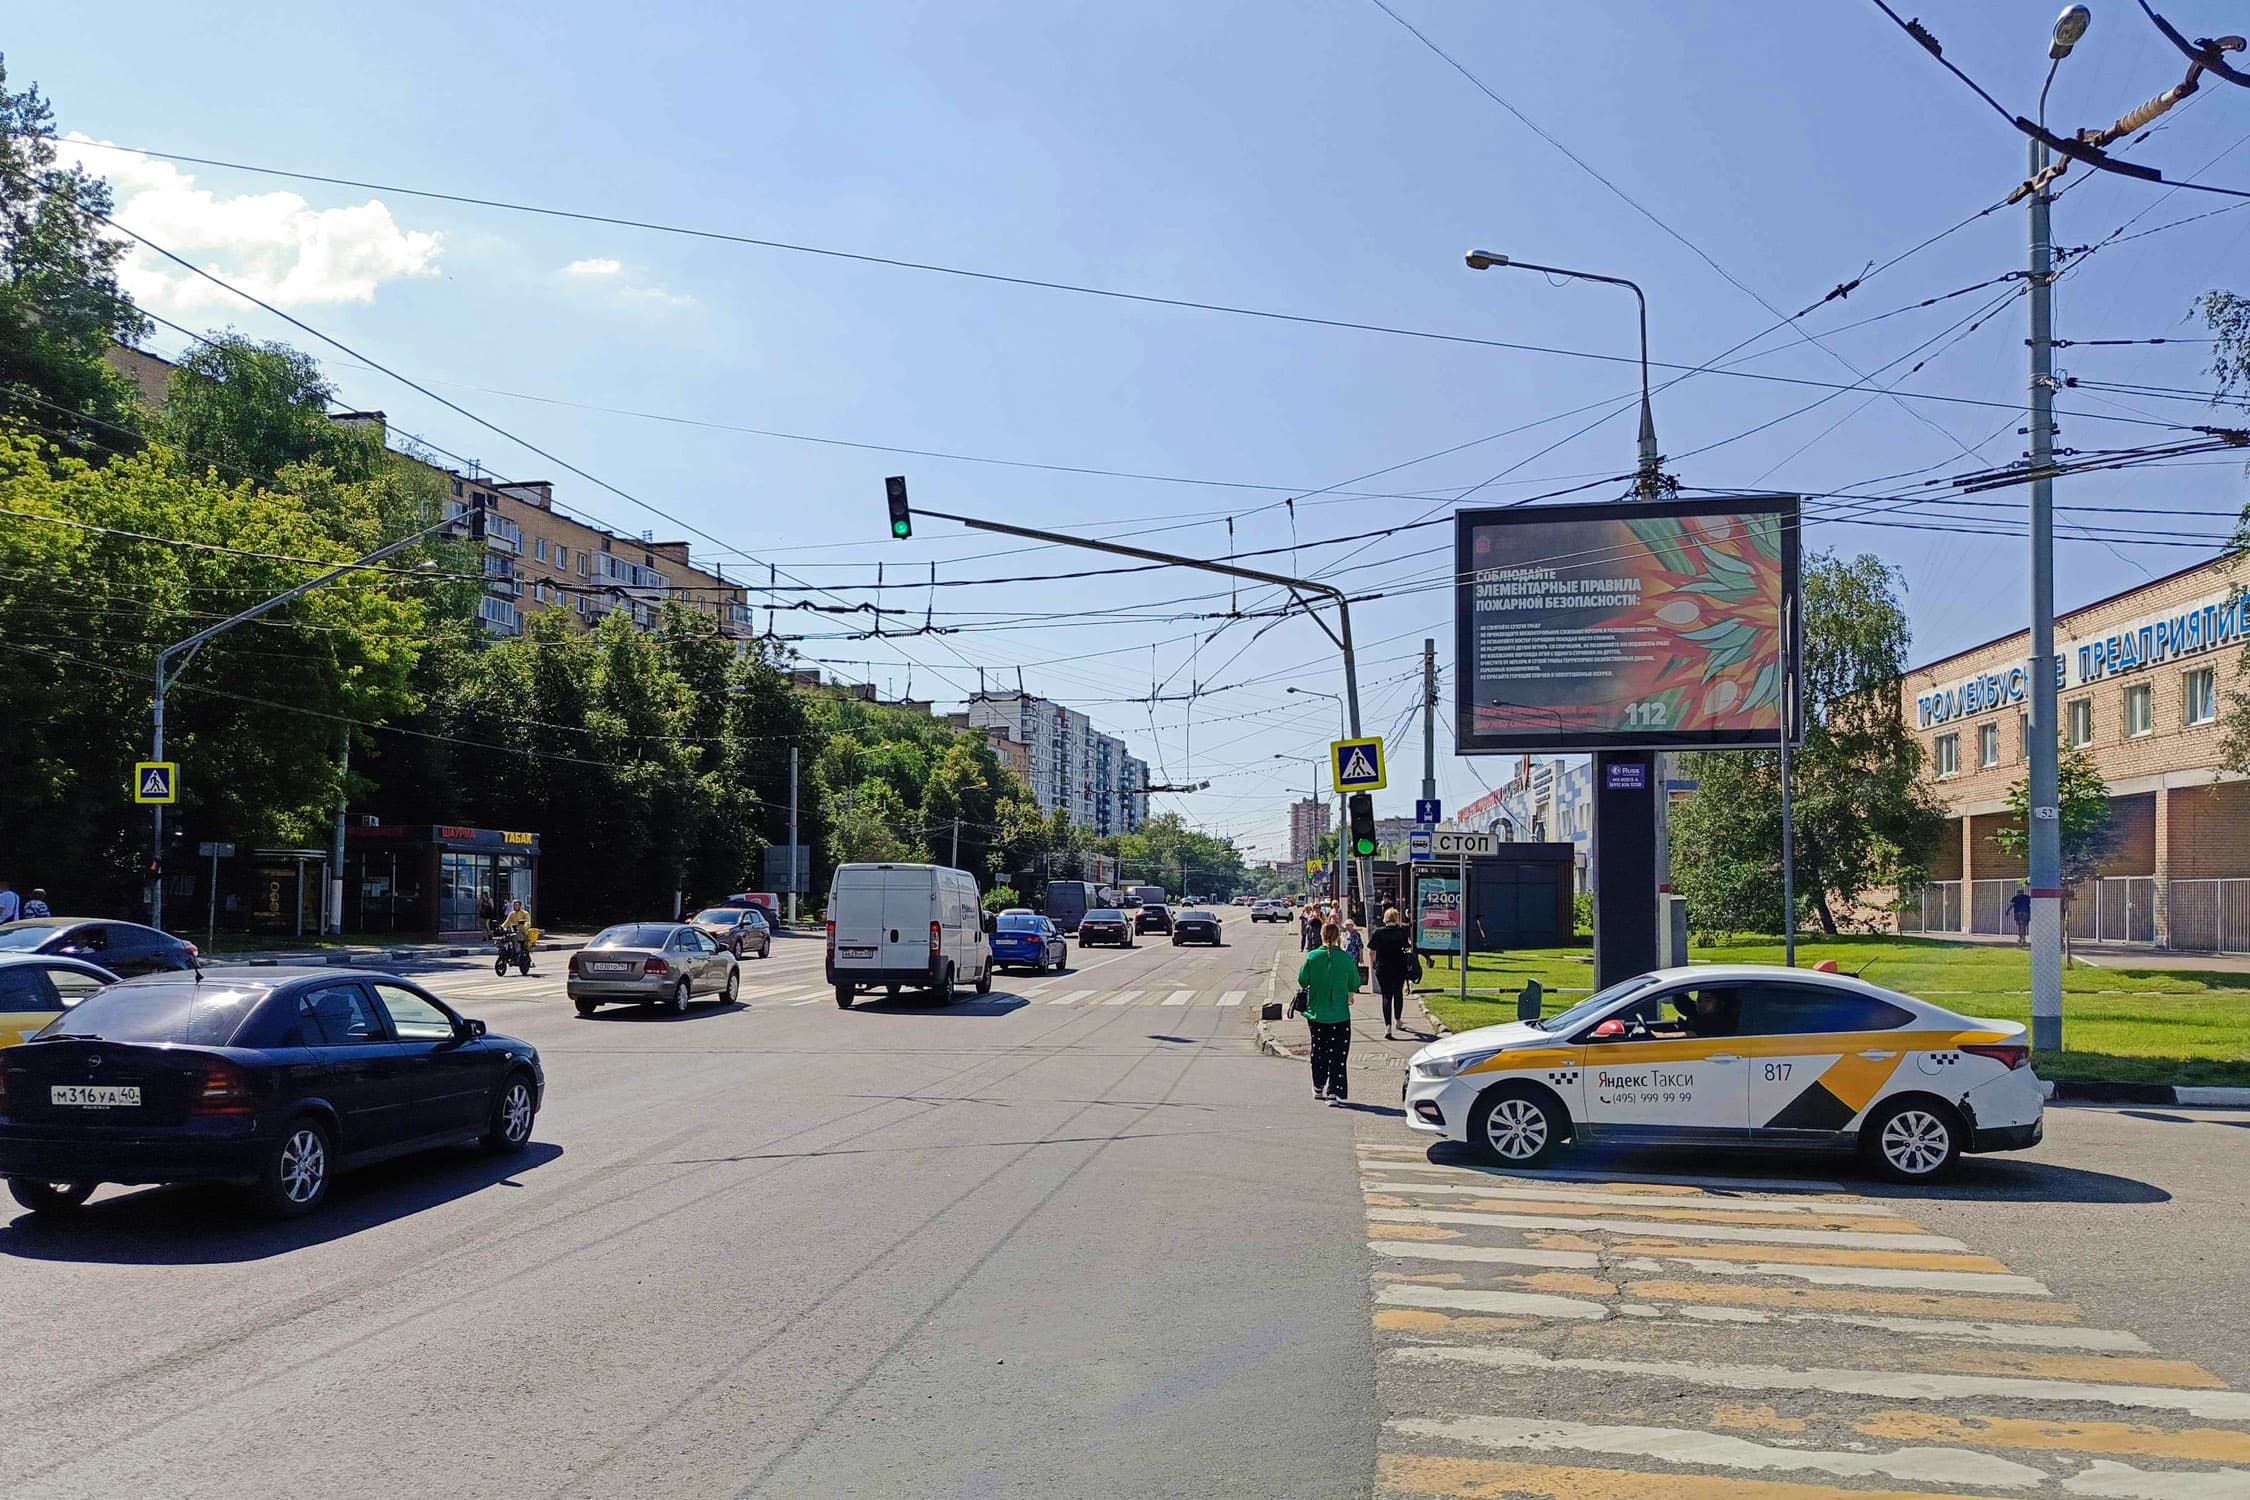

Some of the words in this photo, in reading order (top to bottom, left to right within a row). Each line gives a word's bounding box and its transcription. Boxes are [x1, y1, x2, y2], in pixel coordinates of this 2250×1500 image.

[1476, 567, 1556, 582] СОБЛЮДАЙТЕ
[1476, 580, 1578, 597] ЭЛЕМЕНТАРНЫЕ
[1580, 578, 1642, 592] ПРАВИЛА
[1476, 596, 1543, 612] ПОЖАРНОЙ
[1544, 594, 1641, 609] БЕЗОПАСНОСТИ:
[1625, 702, 1667, 726] 112
[2041, 808, 2053, 818] 52
[503, 831, 532, 844] ТАБАК
[1439, 836, 1489, 852] СТОП
[1598, 1071, 1648, 1089] Яндекс
[1651, 1070, 1694, 1087] Такси
[1764, 1063, 1793, 1082] 817
[120, 1088, 135, 1100] 40
[1612, 1093, 1637, 1104] (495)
[1640, 1092, 1659, 1103] 999
[1662, 1092, 1676, 1103] 99
[1679, 1091, 1692, 1102] 99
